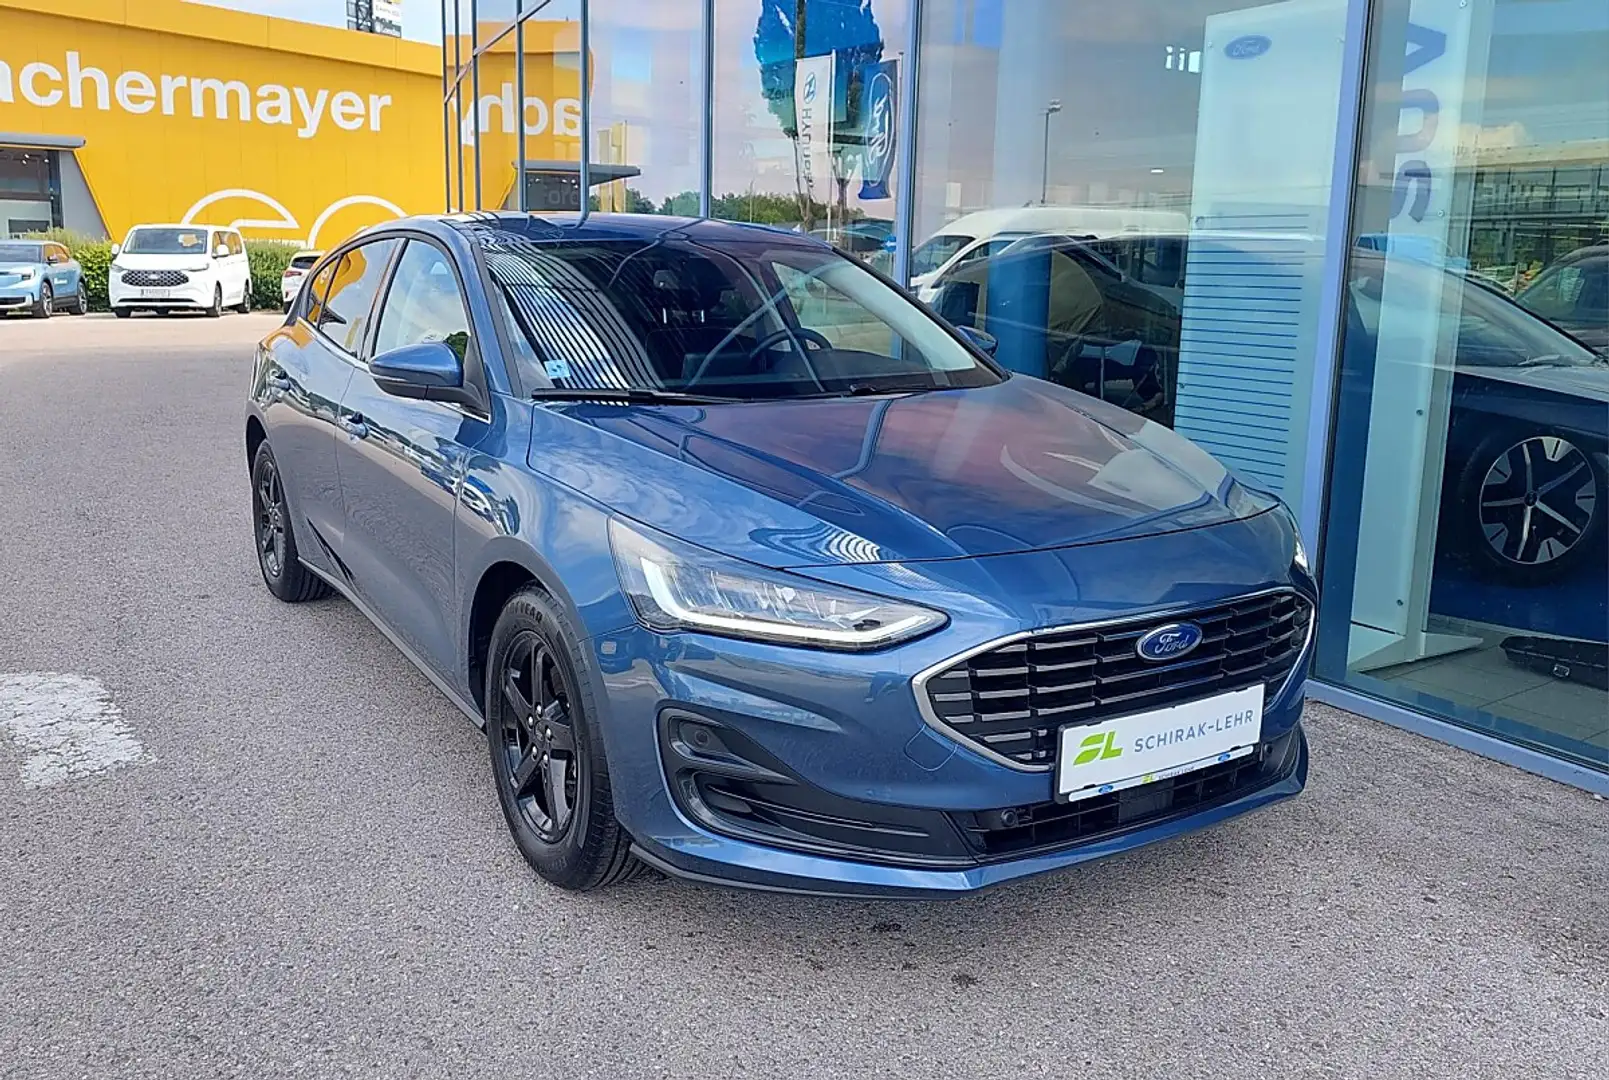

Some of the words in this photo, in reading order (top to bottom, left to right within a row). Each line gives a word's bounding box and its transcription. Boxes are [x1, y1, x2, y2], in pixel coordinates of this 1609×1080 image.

[1390, 22, 1447, 222] SUV
[1154, 632, 1190, 656] Ford
[1134, 709, 1254, 752] SCHIRAK-LEHR
